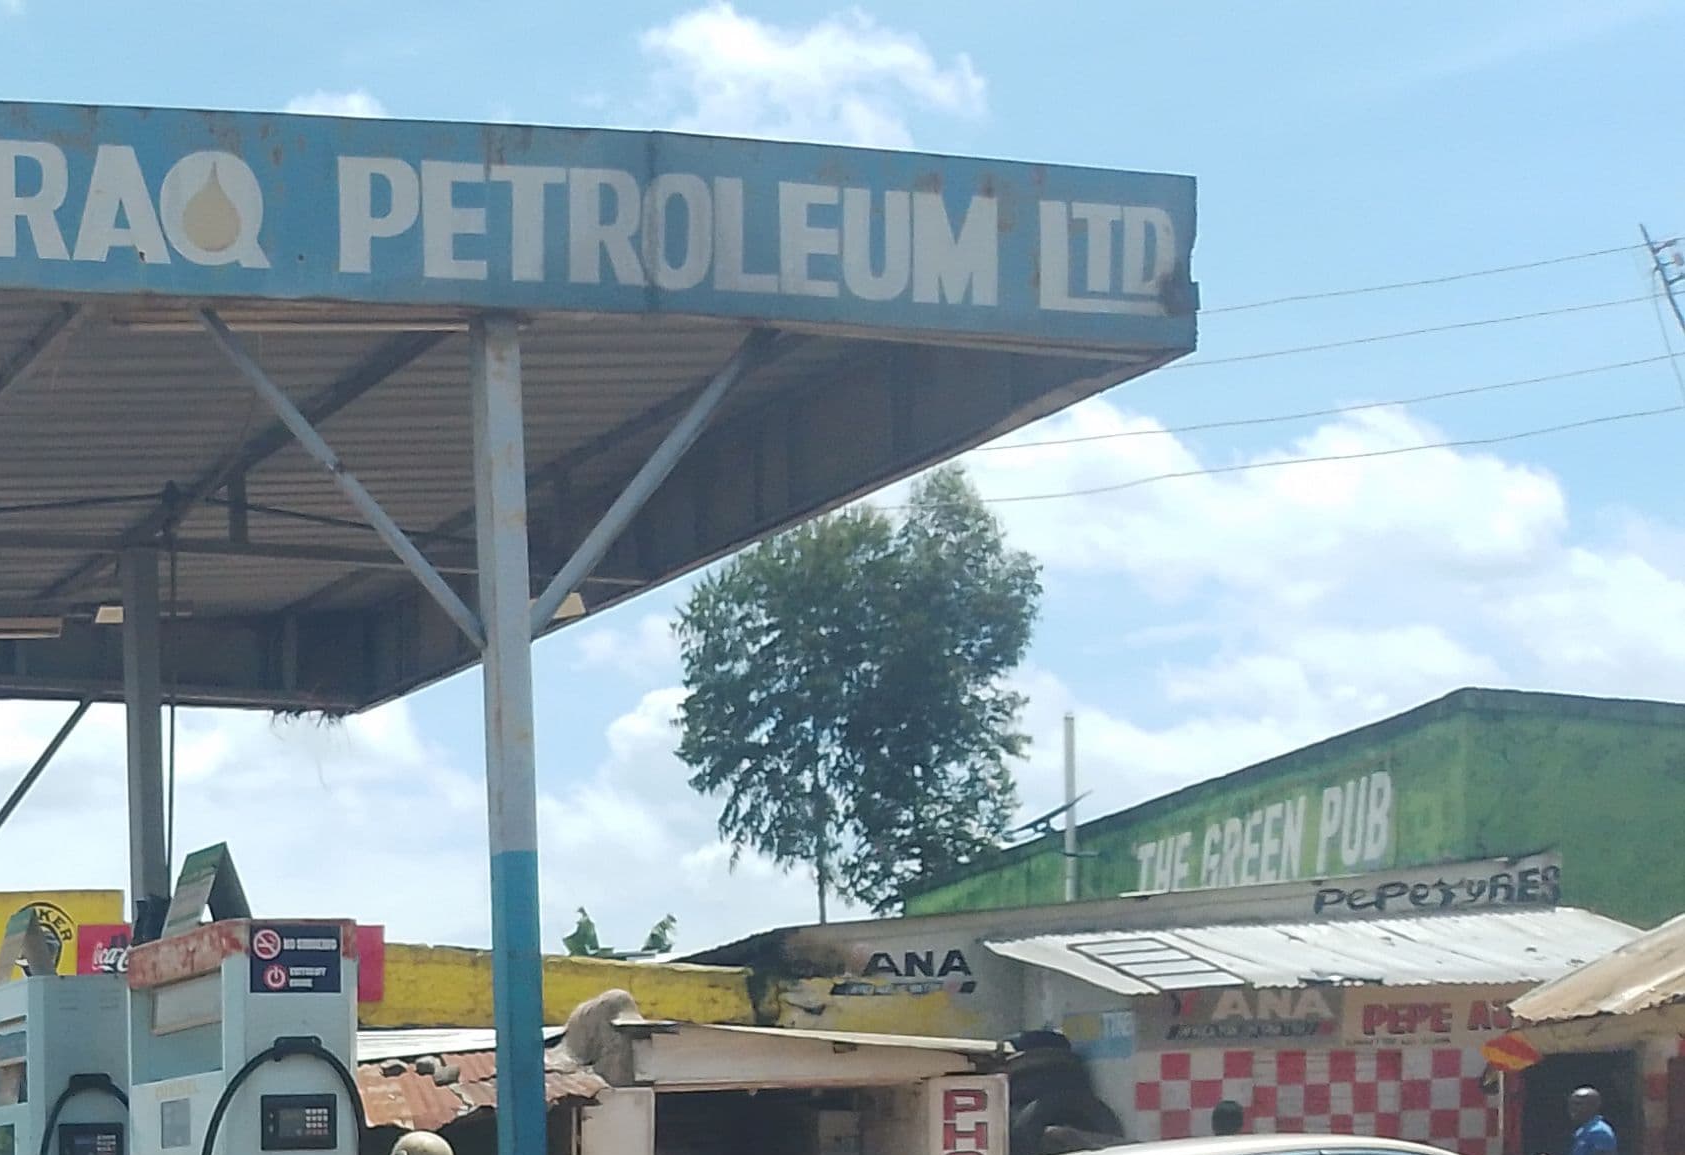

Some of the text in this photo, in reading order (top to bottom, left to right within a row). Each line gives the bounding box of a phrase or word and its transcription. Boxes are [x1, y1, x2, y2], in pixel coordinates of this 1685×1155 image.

[337, 156, 999, 307] PETROLEUM
[1039, 200, 1176, 316] LTD
[1137, 771, 1394, 891] THE GREEN PUB
[38, 908, 73, 942] KER
[862, 949, 972, 977] ANA
[1362, 1002, 1453, 1034] PEPE
